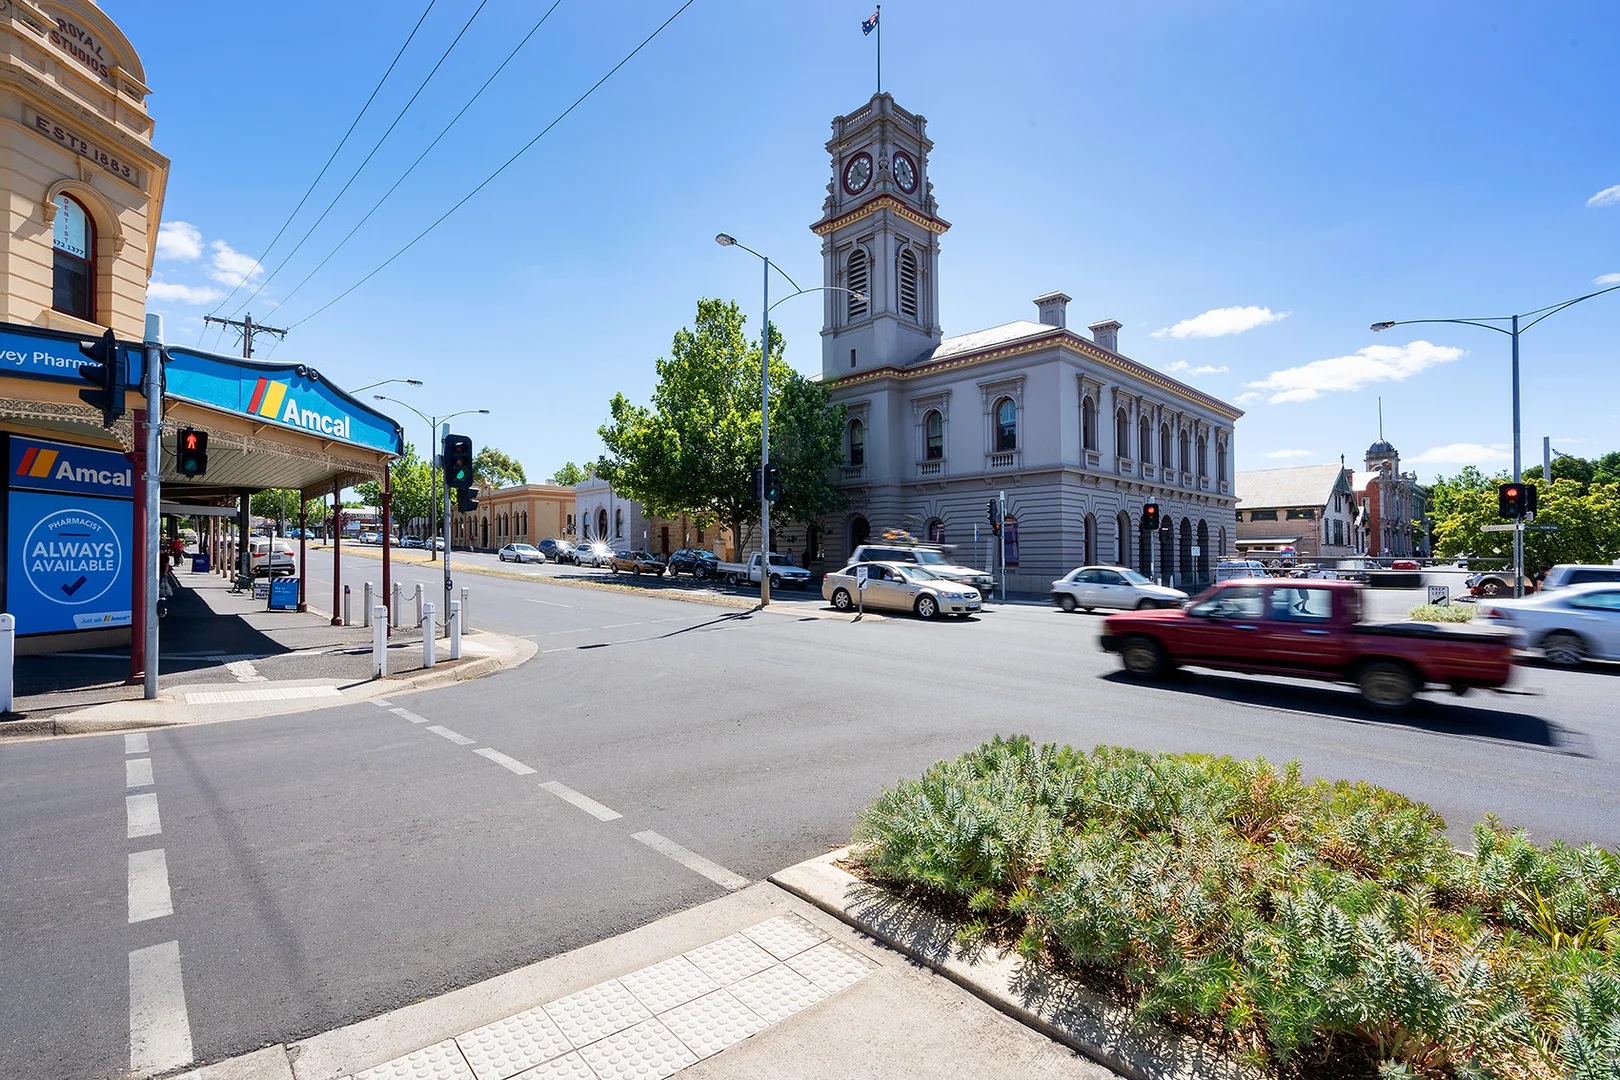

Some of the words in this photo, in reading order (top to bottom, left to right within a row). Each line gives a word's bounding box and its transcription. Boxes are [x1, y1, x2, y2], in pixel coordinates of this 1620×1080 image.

[56, 17, 104, 61] ROYAL
[51, 30, 108, 79] STUDIOS
[94, 150, 131, 178] 1883
[67, 244, 84, 255] 1377
[282, 397, 351, 439] Amcal
[55, 461, 132, 487] Amcal
[48, 517, 102, 532] PHARMACIST
[31, 541, 115, 558] ALWAYS
[31, 559, 115, 572] AVAILABLE
